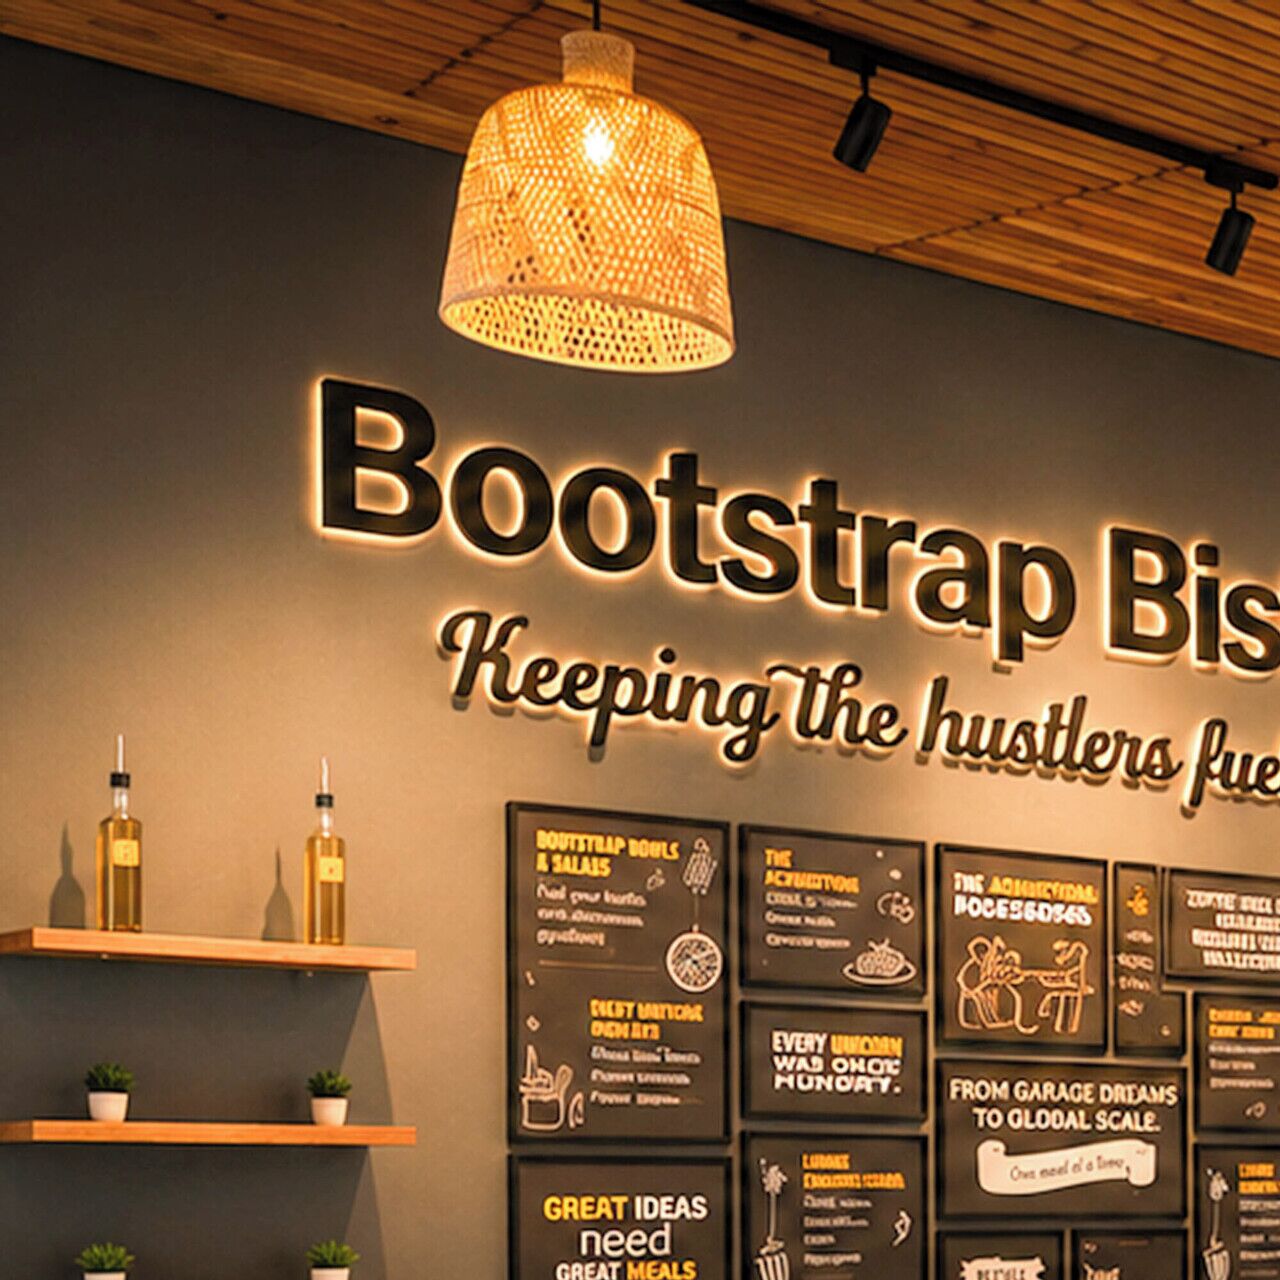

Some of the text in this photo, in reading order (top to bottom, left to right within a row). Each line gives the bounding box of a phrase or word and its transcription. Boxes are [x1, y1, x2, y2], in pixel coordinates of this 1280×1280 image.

[319, 377, 1076, 663] Bootstrap
[440, 610, 781, 763] Keeping
[766, 662, 908, 748] the
[920, 675, 1183, 782] hustlers
[772, 1030, 827, 1053] EVERY
[949, 1078, 1009, 1101] FROM
[1013, 1080, 1095, 1104] GARAGE
[972, 1107, 1003, 1129] TO
[543, 1195, 709, 1221] GREAT IDEAS
[580, 1222, 672, 1257] need
